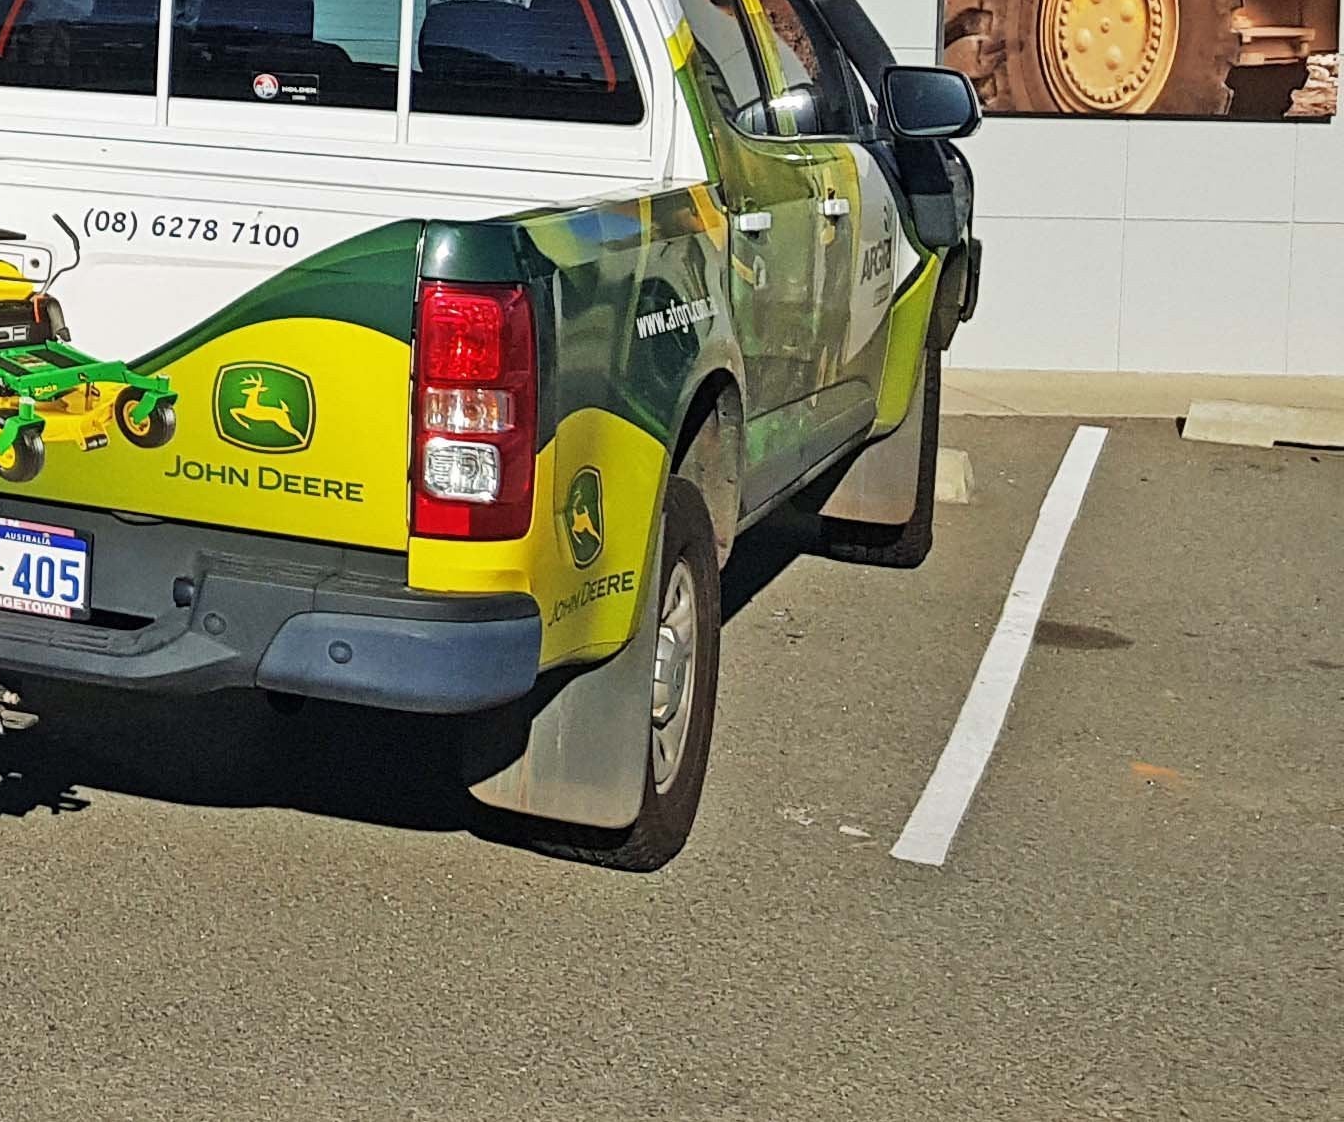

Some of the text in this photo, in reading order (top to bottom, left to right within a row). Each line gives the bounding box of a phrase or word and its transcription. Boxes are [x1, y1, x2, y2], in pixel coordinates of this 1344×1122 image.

[83, 207, 300, 248] (08) 6278 7100
[164, 454, 364, 503] JOHN DEERE
[4, 531, 51, 546] AUSTRALIA
[580, 570, 635, 607] DEERE
